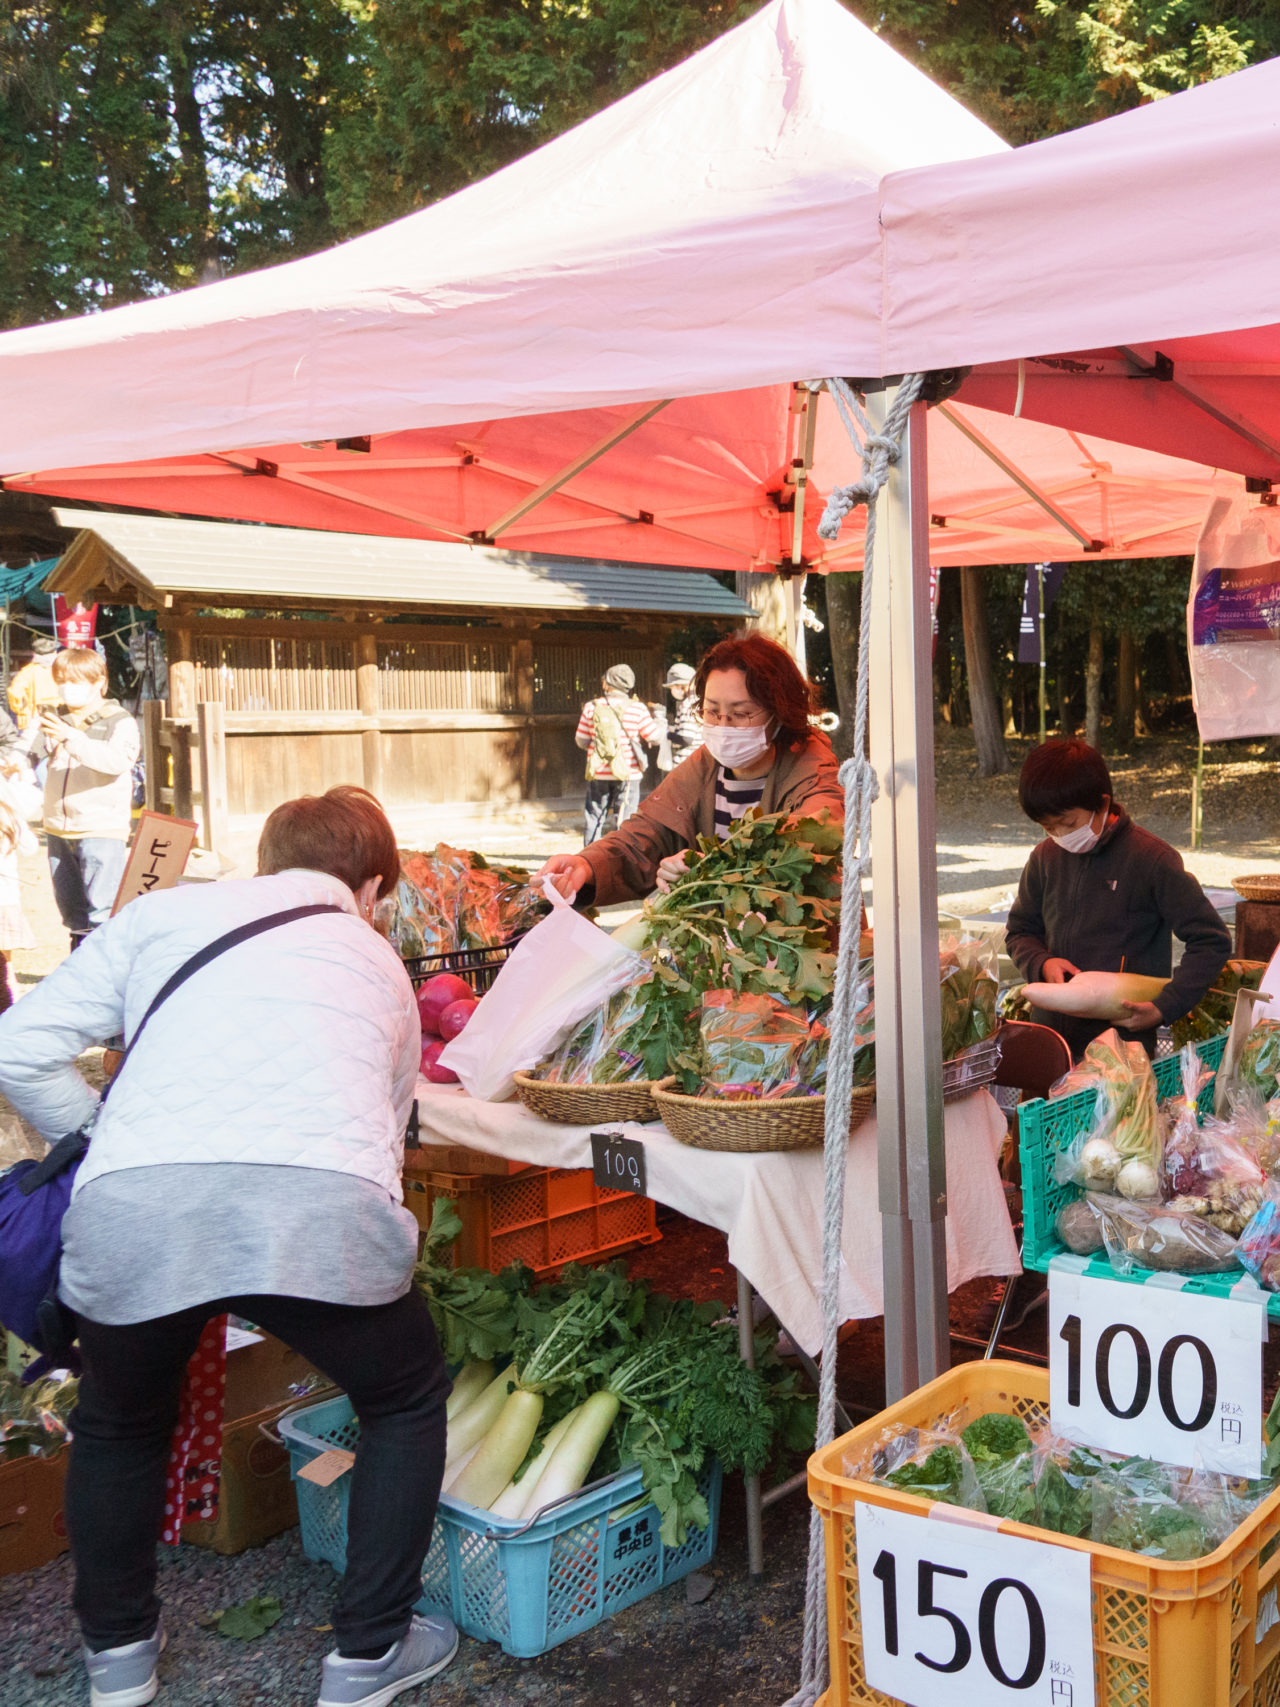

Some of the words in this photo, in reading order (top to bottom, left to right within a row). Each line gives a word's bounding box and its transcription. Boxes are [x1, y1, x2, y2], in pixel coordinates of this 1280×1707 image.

[137, 838, 172, 896] ピーマ
[603, 1148, 639, 1177] 100
[1059, 1314, 1218, 1433] 100
[1220, 1417, 1242, 1445] 円
[1220, 1402, 1244, 1417] 税込
[872, 1549, 1046, 1690] 150
[1050, 1678, 1073, 1707] 円
[1048, 1660, 1075, 1678] 税込
